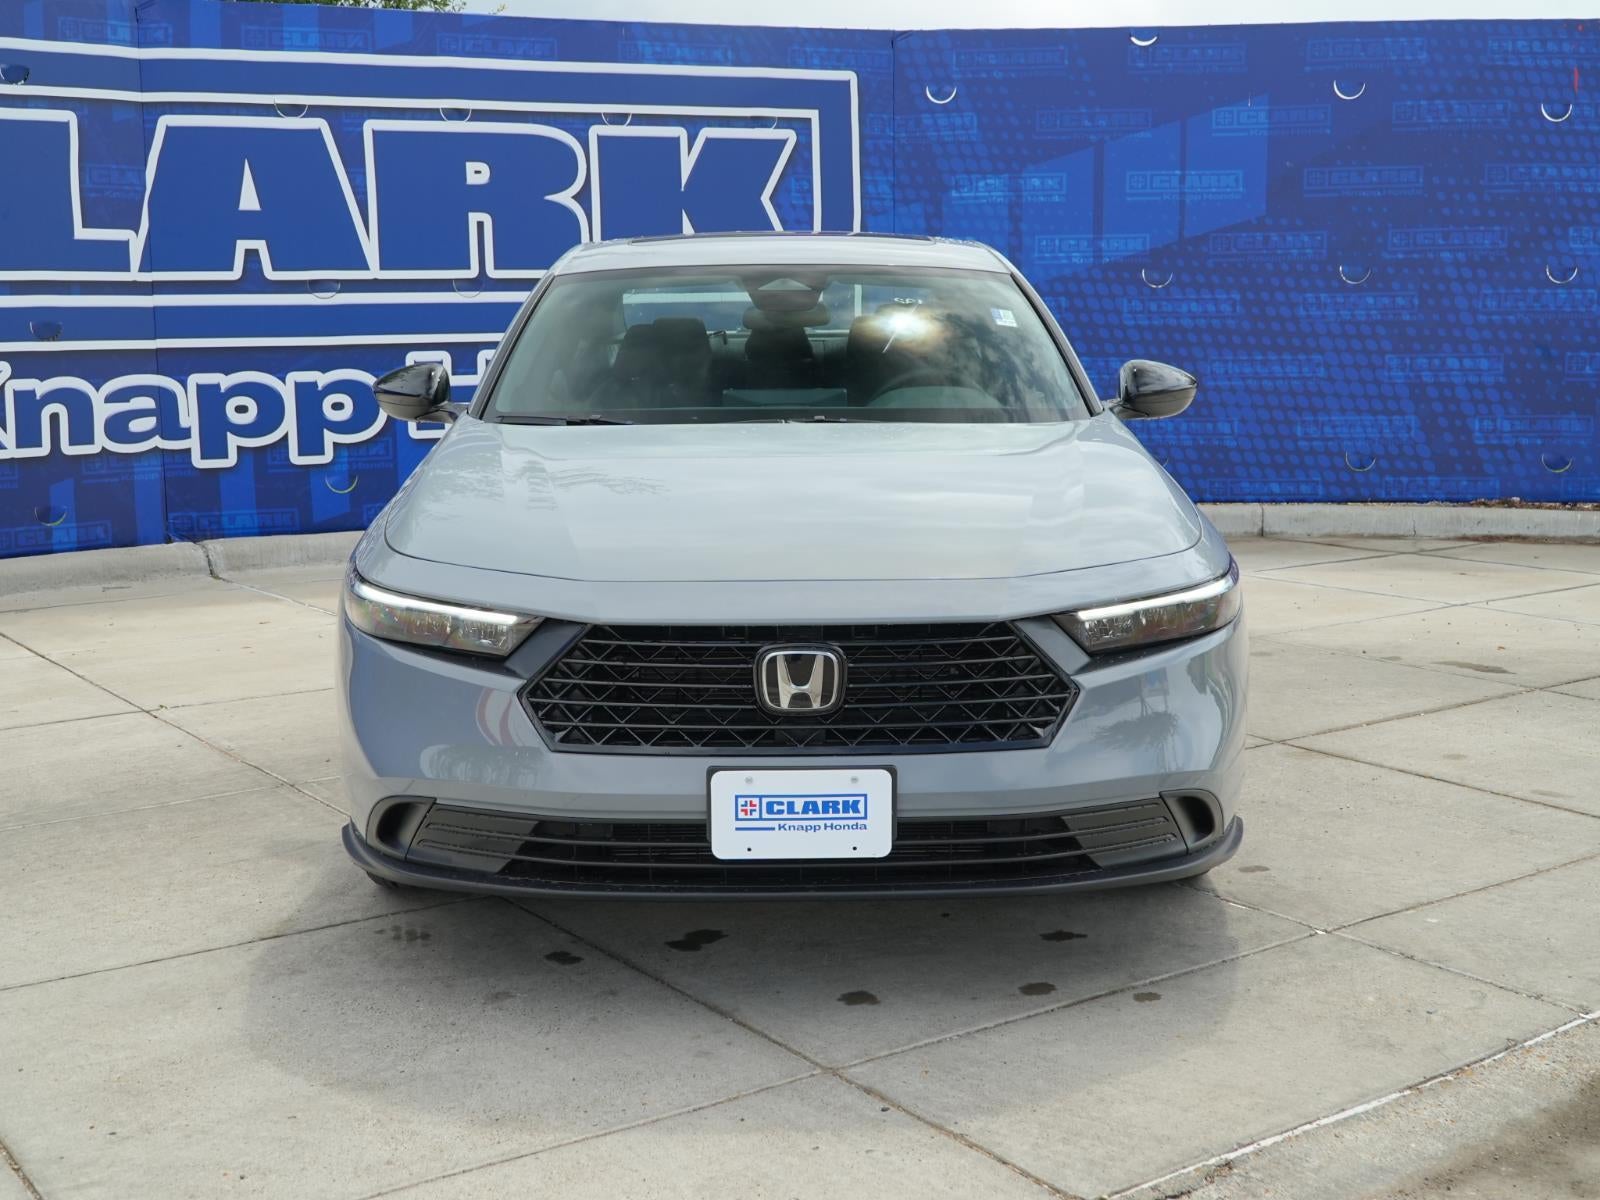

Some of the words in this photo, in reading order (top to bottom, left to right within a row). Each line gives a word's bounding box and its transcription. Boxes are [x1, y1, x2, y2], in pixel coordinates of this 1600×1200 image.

[0, 361, 388, 468] napp
[765, 799, 861, 815] CLARK
[777, 823, 822, 832] Knapp
[824, 822, 867, 831] Honda
